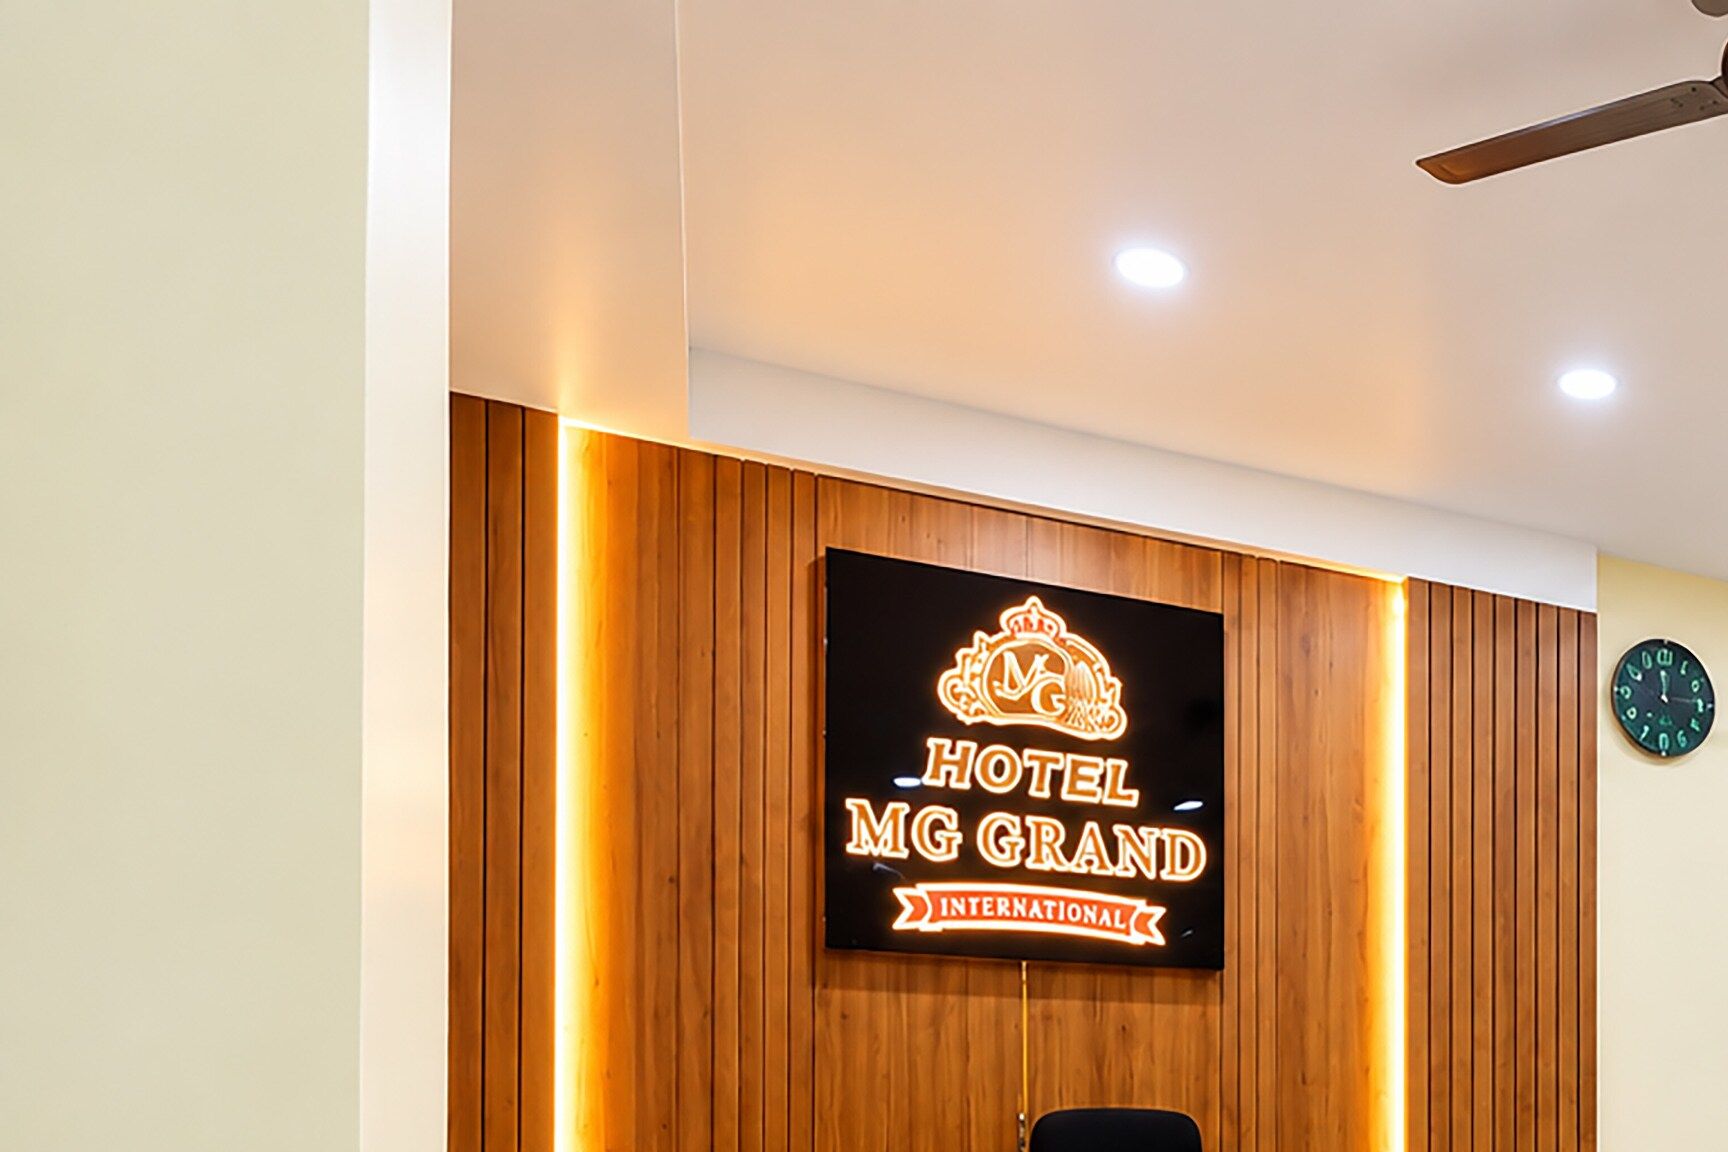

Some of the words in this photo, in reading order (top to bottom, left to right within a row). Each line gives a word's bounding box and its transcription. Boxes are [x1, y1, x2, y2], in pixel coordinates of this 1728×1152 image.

[922, 737, 1140, 807] HOTEL
[846, 799, 962, 862] MG
[976, 812, 1207, 882] GRAND
[940, 896, 1128, 931] INTERNATIONAL
